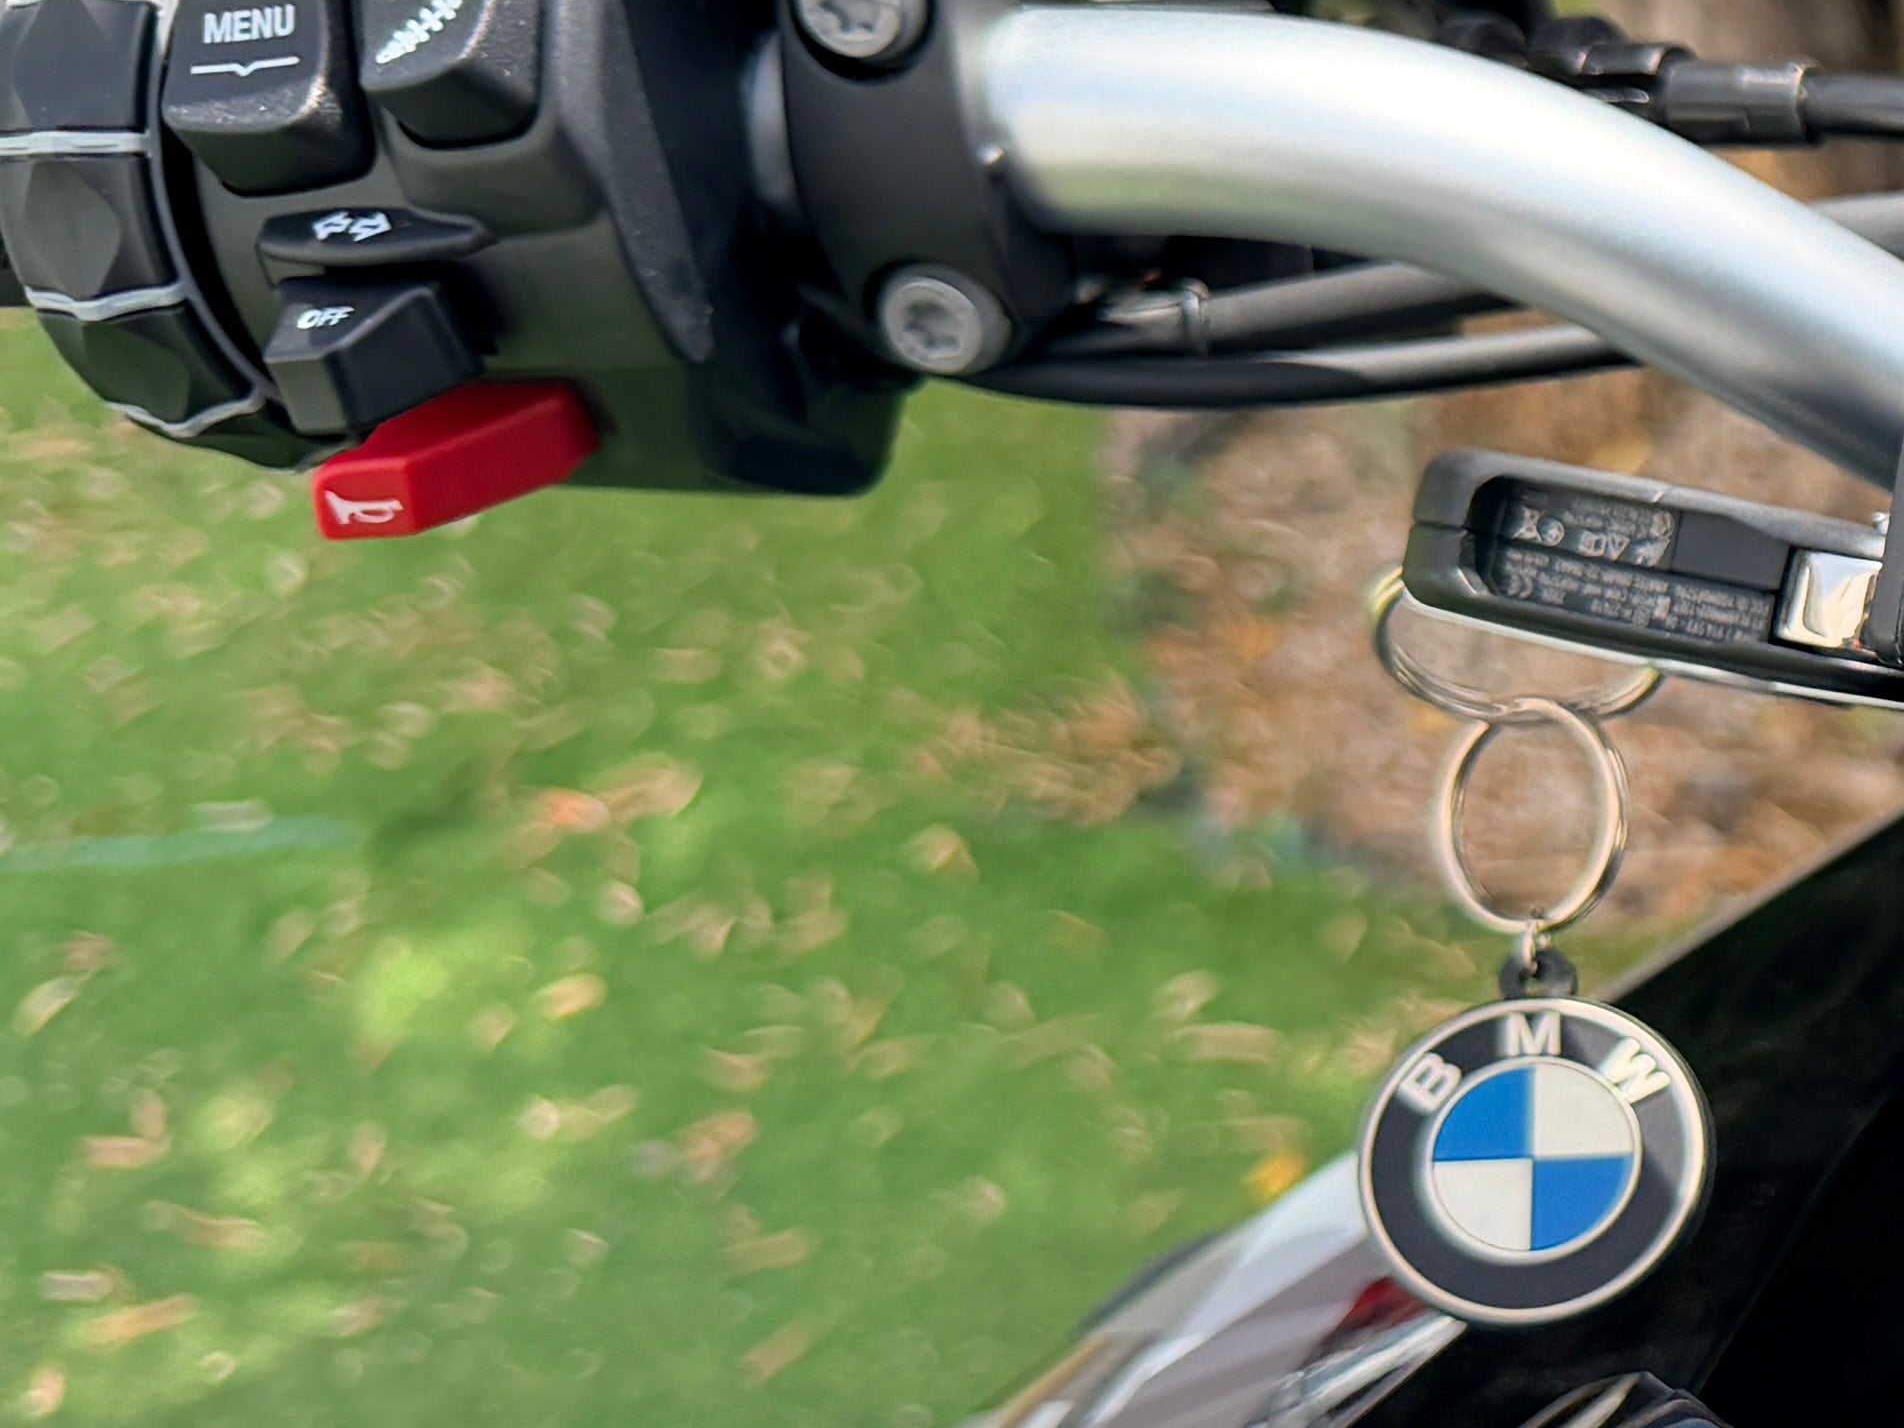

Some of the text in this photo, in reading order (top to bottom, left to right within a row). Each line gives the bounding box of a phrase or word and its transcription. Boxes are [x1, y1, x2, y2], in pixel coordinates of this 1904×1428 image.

[203, 4, 296, 44] MENU
[296, 305, 354, 329] OFF
[1398, 1010, 1672, 1112] BMW
